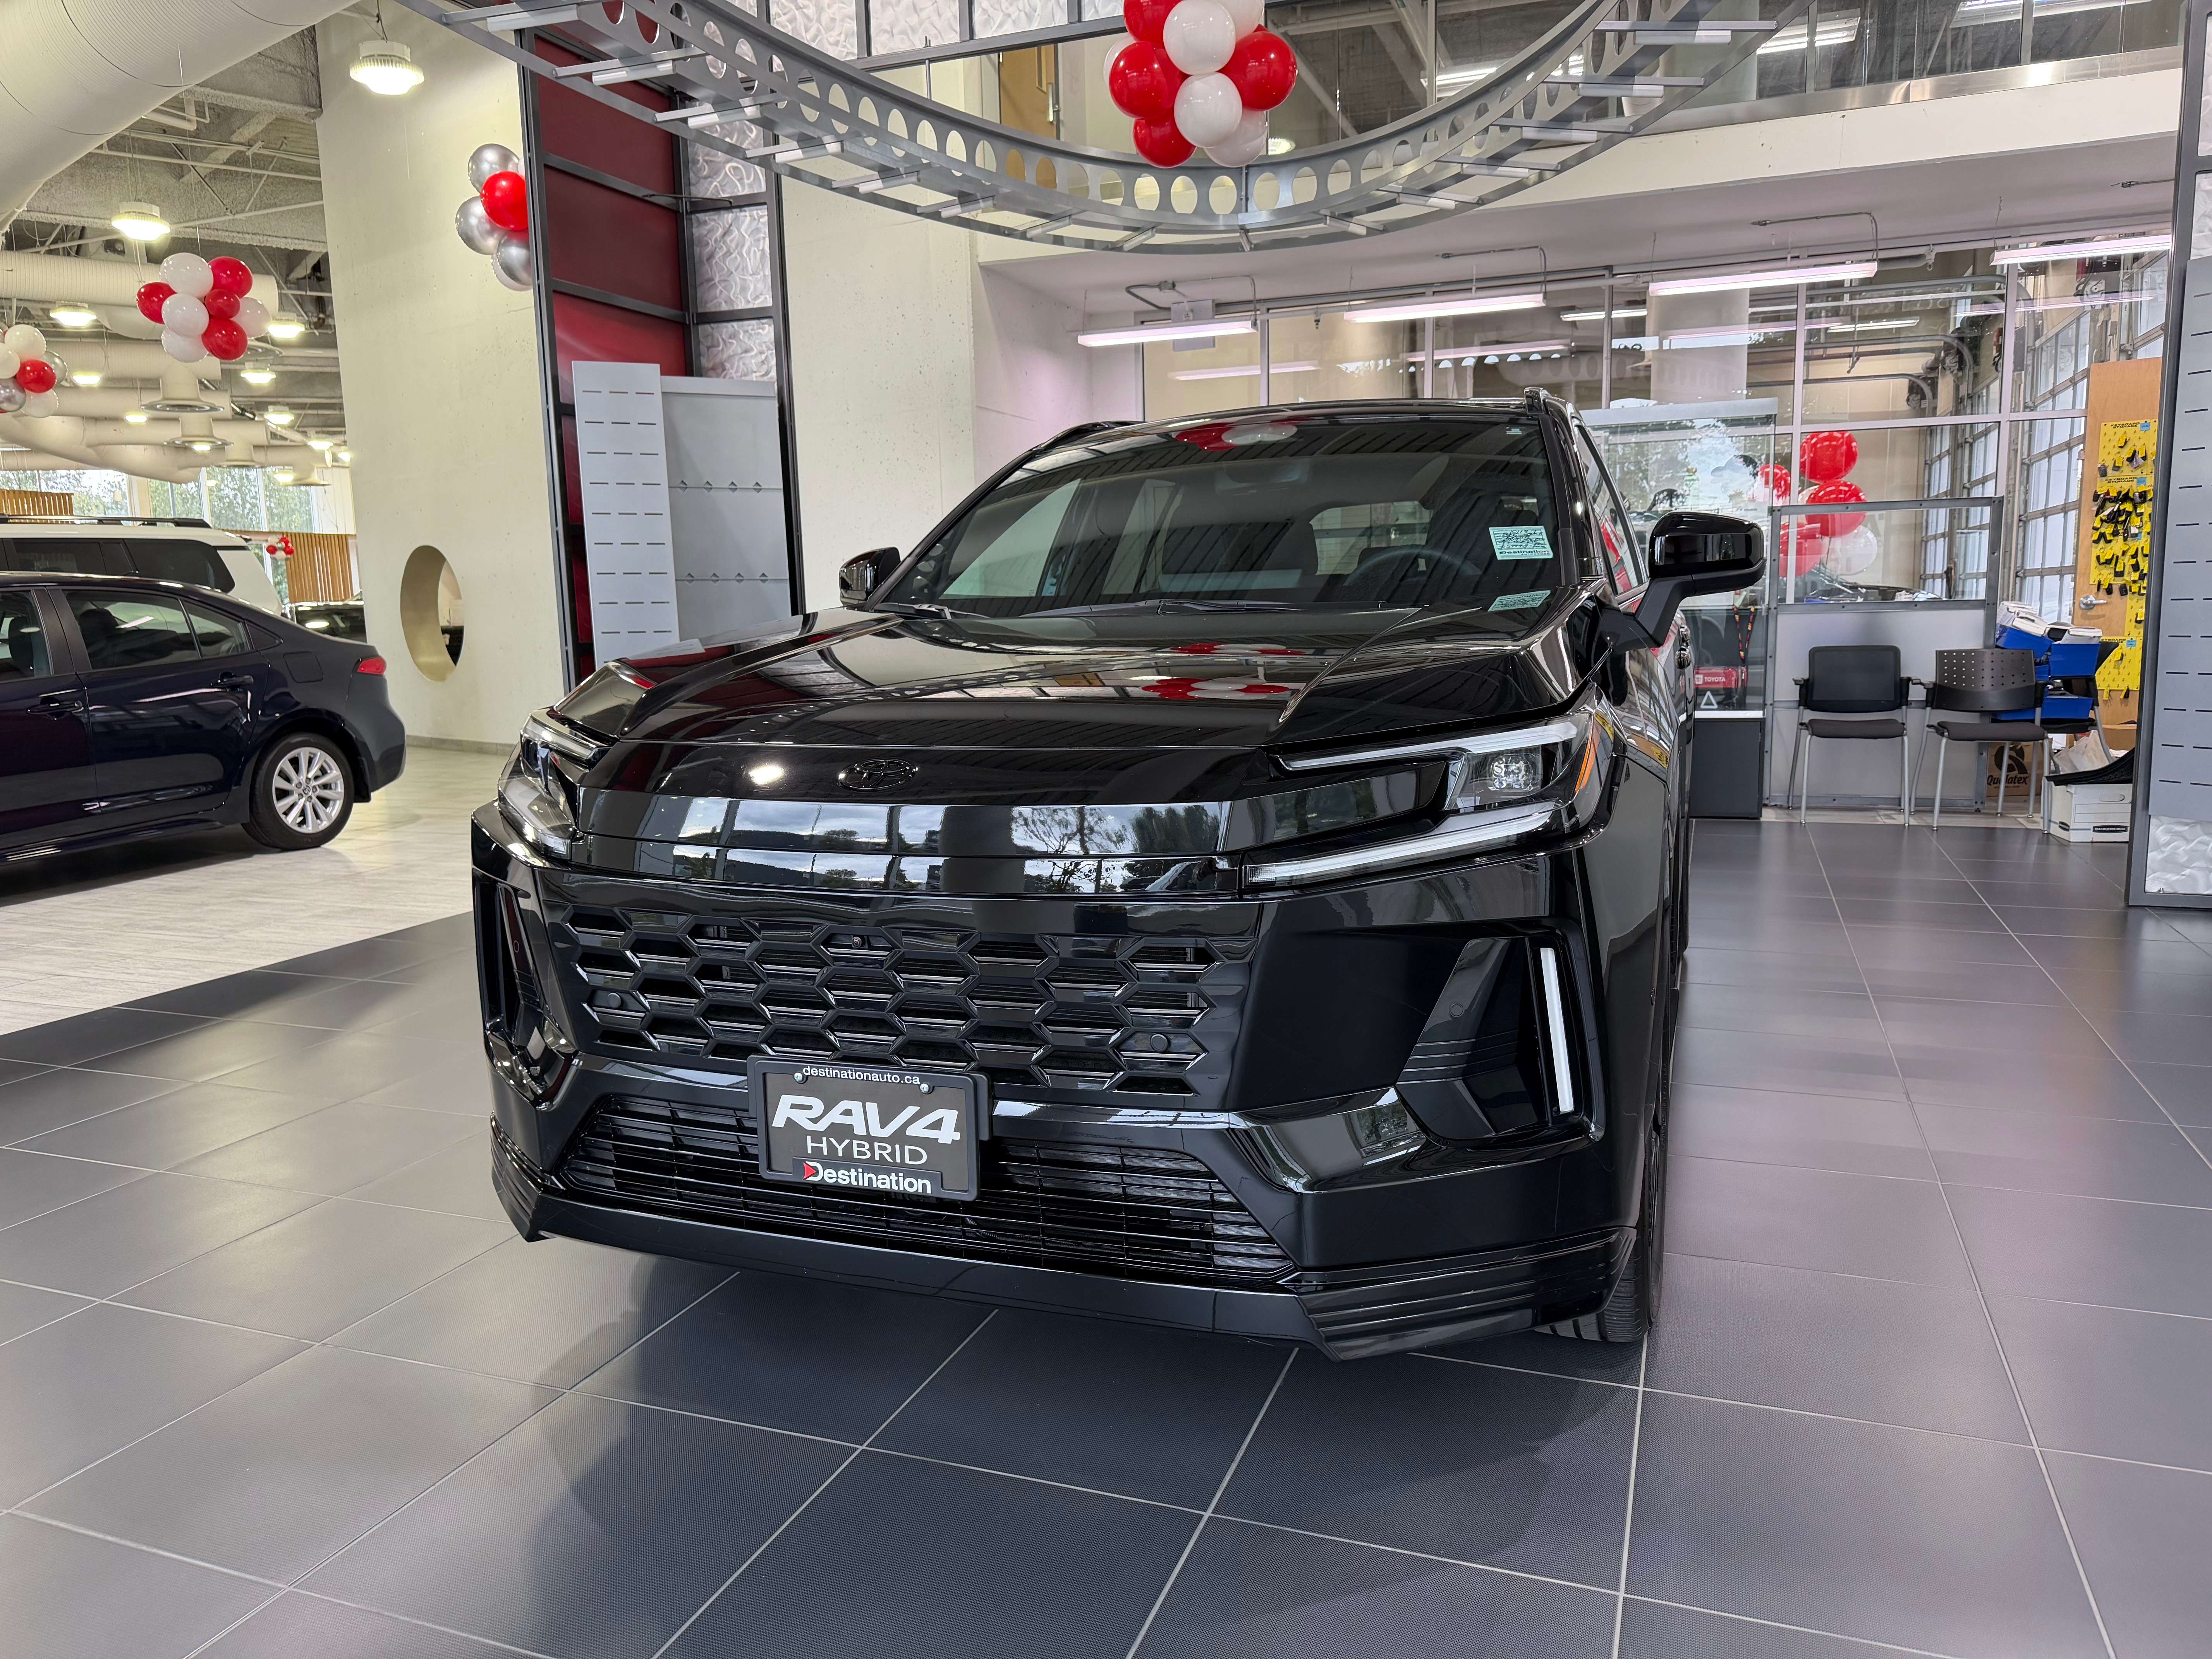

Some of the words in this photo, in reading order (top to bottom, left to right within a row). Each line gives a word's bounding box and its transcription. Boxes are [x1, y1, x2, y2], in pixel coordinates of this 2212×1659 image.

[803, 1065, 921, 1084] destinationauto.ca
[772, 1094, 960, 1144] RAV4
[806, 1135, 927, 1164] HYBRID
[804, 1161, 931, 1194] Destination
